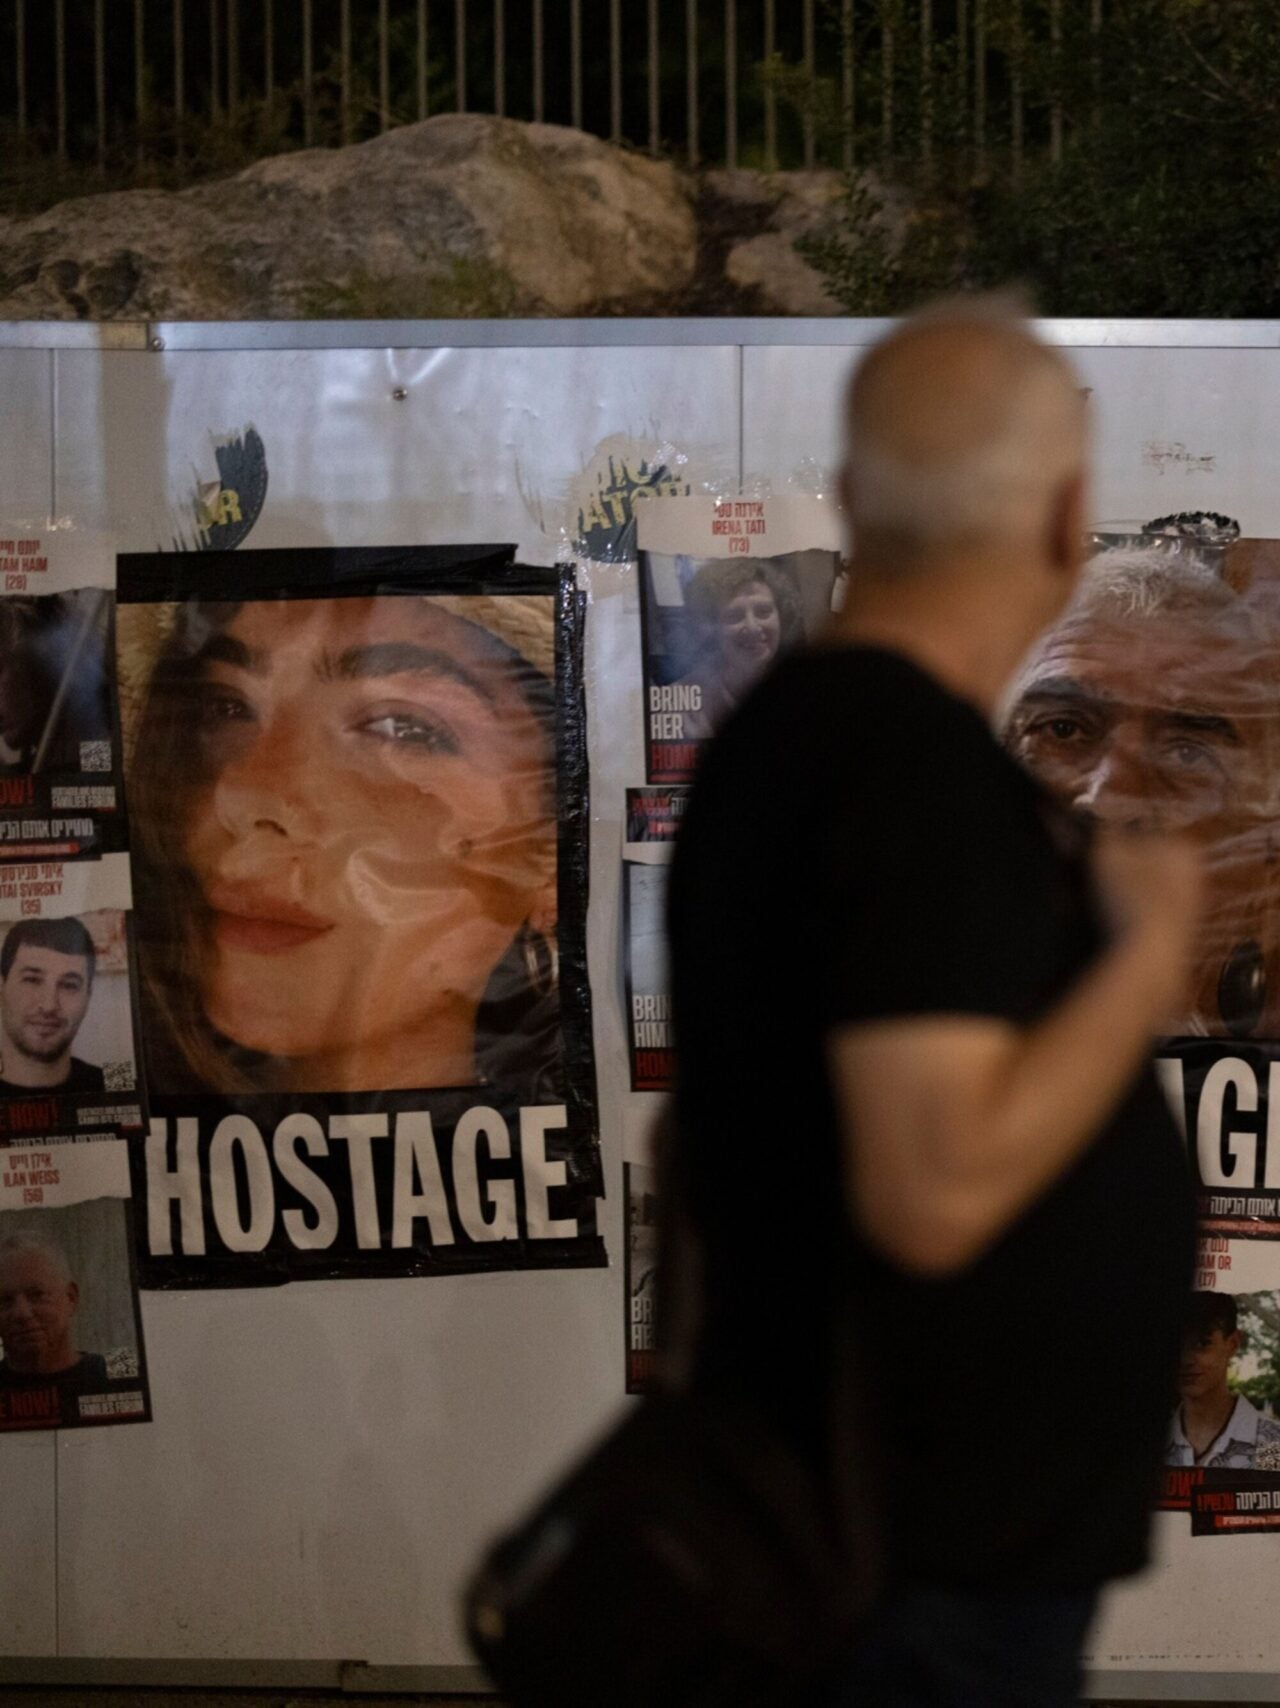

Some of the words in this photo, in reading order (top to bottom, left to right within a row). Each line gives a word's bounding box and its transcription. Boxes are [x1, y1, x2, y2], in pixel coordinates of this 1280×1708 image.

[712, 519, 743, 535] IRENA
[745, 519, 766, 535] TATI
[729, 536, 750, 554] (73)
[650, 684, 702, 712] BRING
[651, 713, 684, 740] HER
[652, 744, 700, 770] HOM
[28, 1170, 60, 1186] WEISS
[145, 1105, 579, 1256] HOSTAGE
[1218, 1255, 1232, 1270] OR
